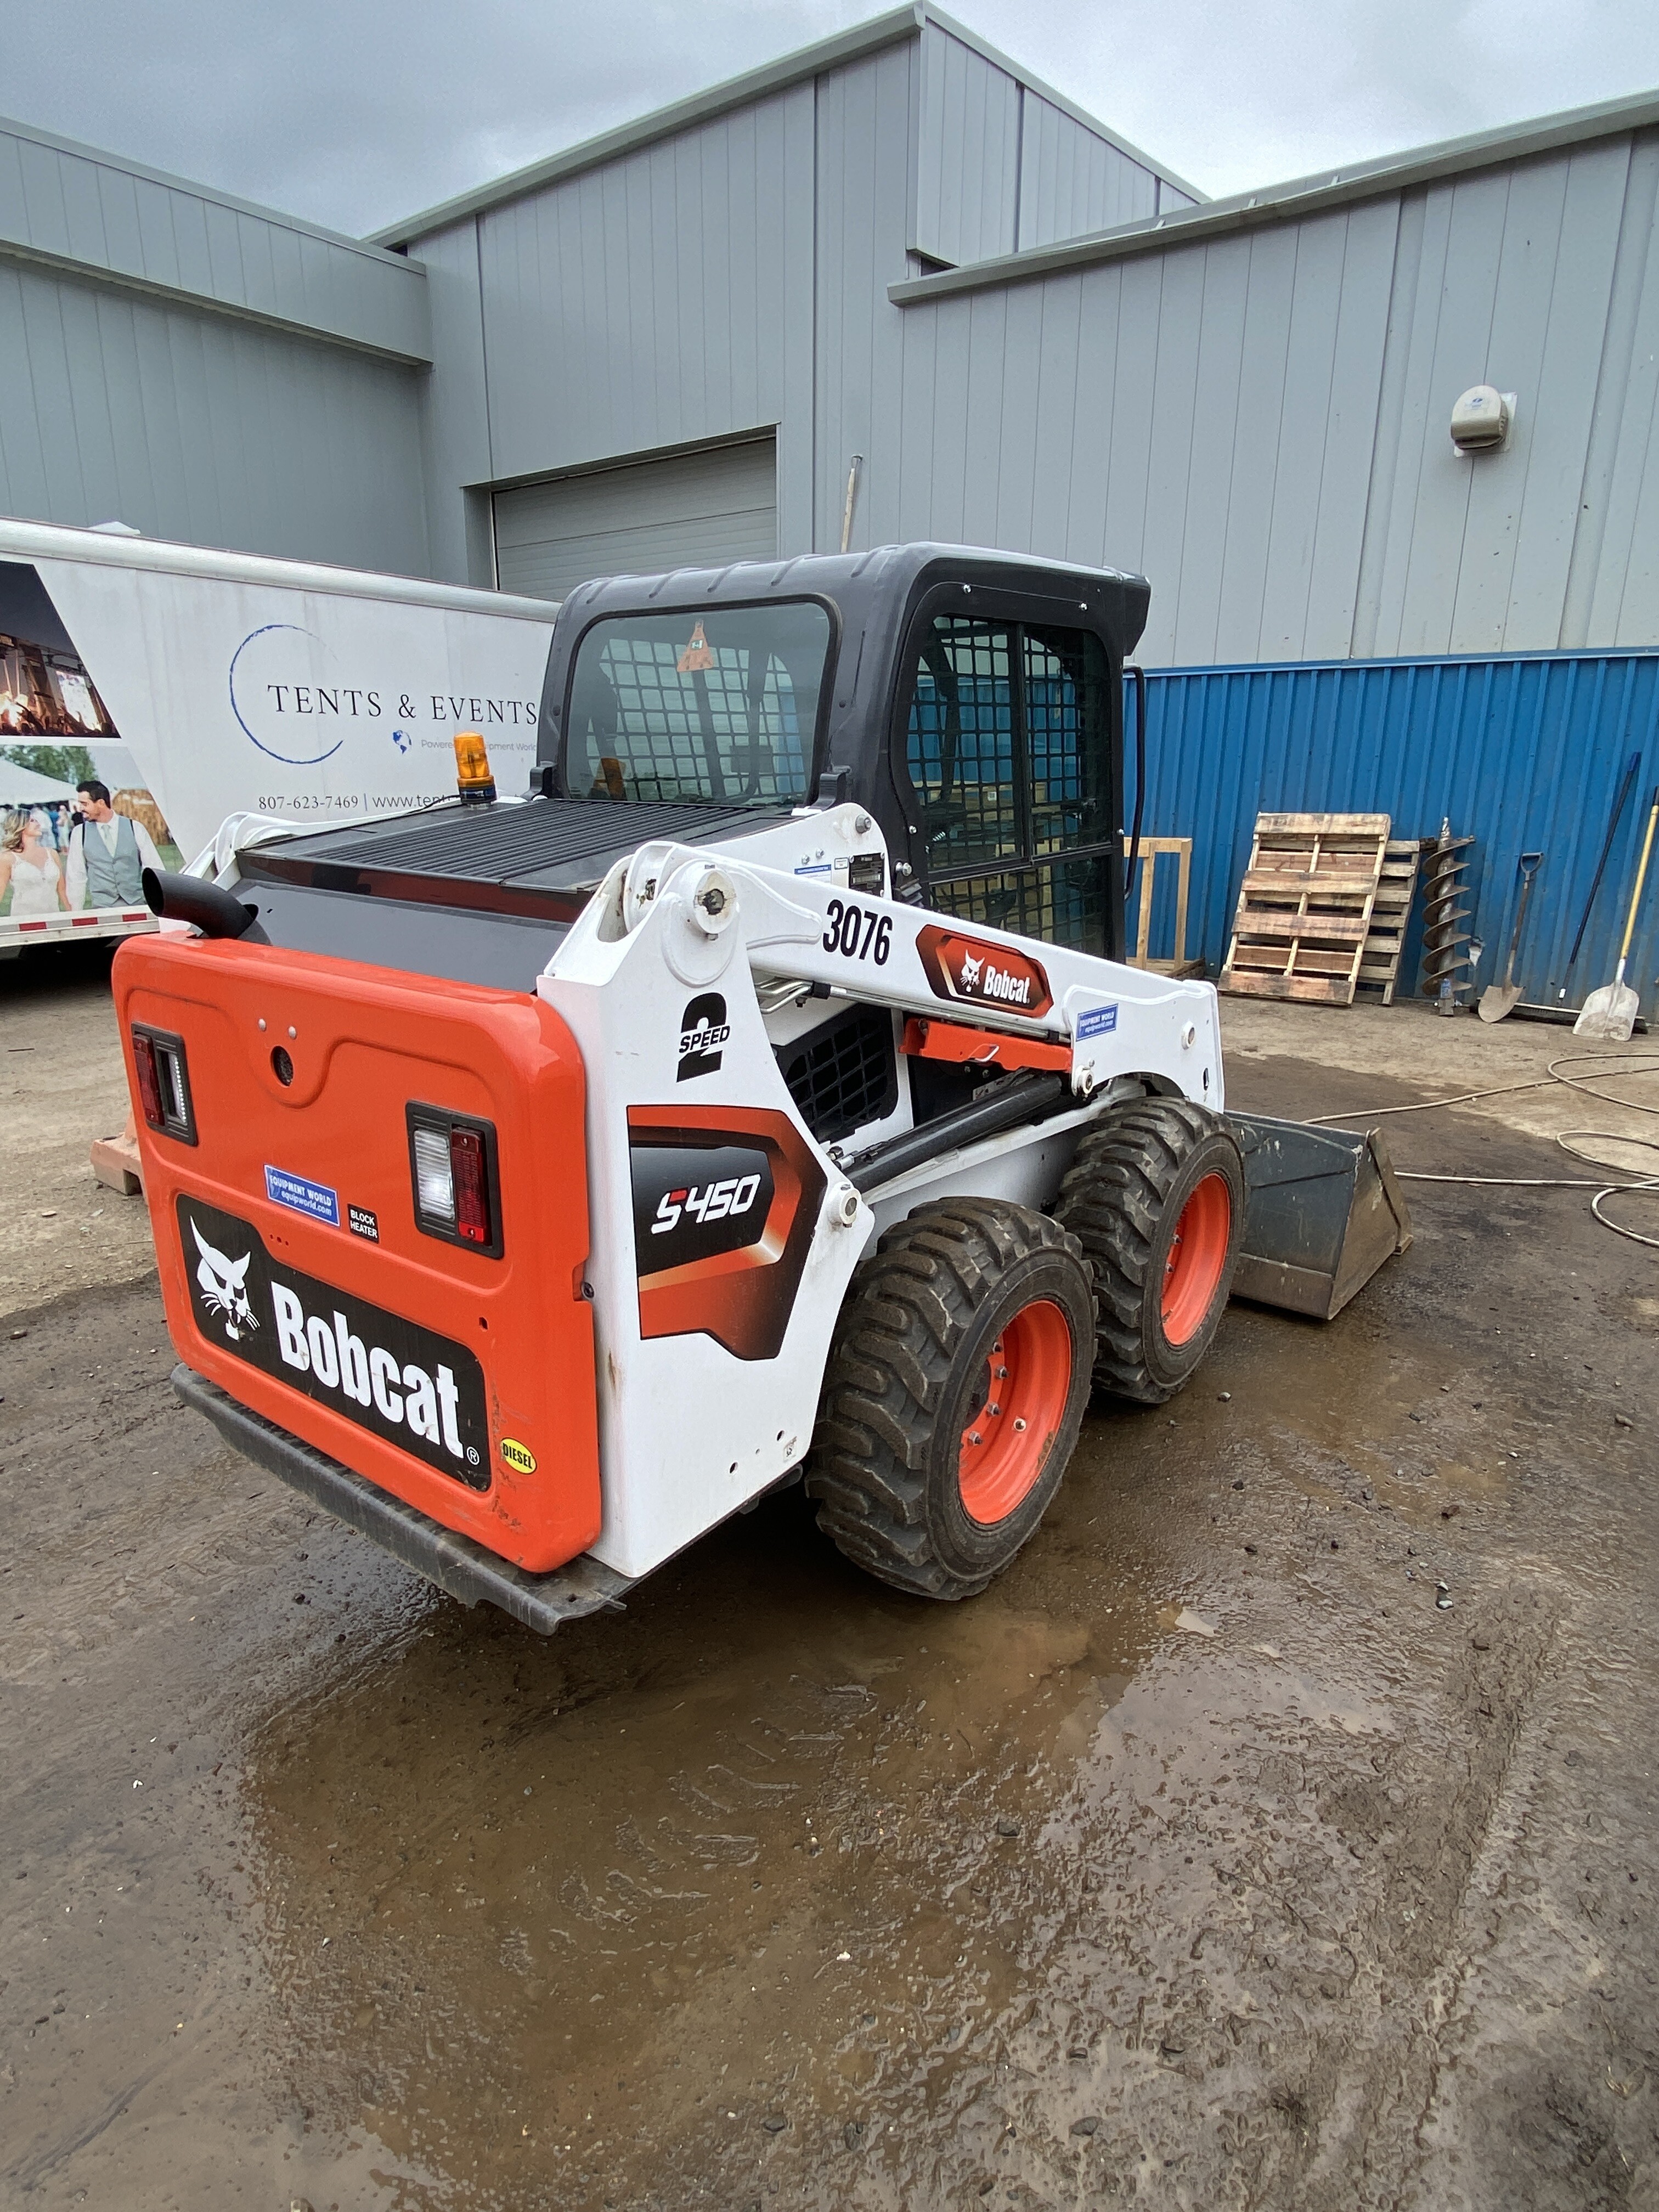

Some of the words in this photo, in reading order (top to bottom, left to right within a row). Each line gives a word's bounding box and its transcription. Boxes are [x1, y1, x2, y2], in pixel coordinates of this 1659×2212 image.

[267, 685, 381, 717] TENTS
[398, 693, 416, 718] &
[430, 696, 537, 725] EVENTS
[421, 739, 454, 749] Powere
[258, 794, 359, 810] 807-623-7469
[823, 899, 893, 966] 3076
[983, 965, 1030, 1004] Bobcat
[679, 1025, 731, 1053] SPEED
[269, 1174, 306, 1196] EQUIPMENT
[307, 1188, 332, 1206] WORLD
[281, 1190, 332, 1216] equipworld.com
[651, 1173, 761, 1234] S450
[350, 1209, 375, 1226] BLOCK
[350, 1220, 378, 1238] HEATER
[271, 1281, 464, 1459] Bobcat
[503, 1442, 533, 1469] DIESEL
